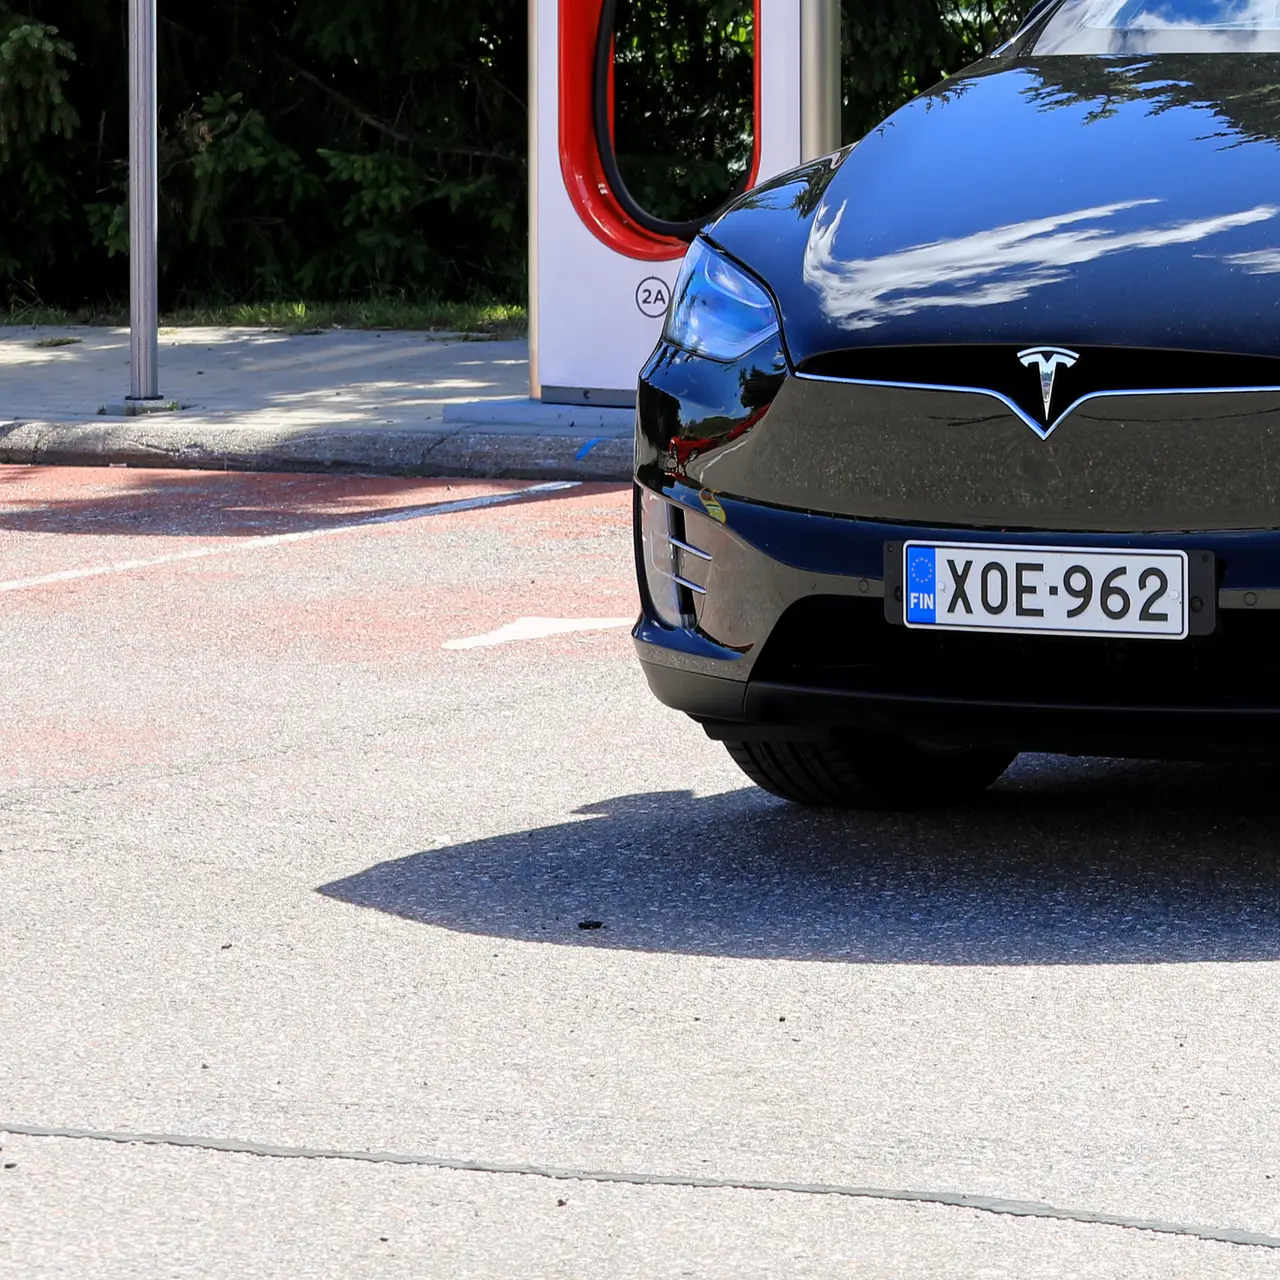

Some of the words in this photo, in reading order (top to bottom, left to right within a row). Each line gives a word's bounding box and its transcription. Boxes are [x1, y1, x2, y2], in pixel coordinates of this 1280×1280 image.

[641, 288, 666, 305] 2A
[946, 558, 1169, 622] XOE-962
[910, 592, 935, 610] FIN
